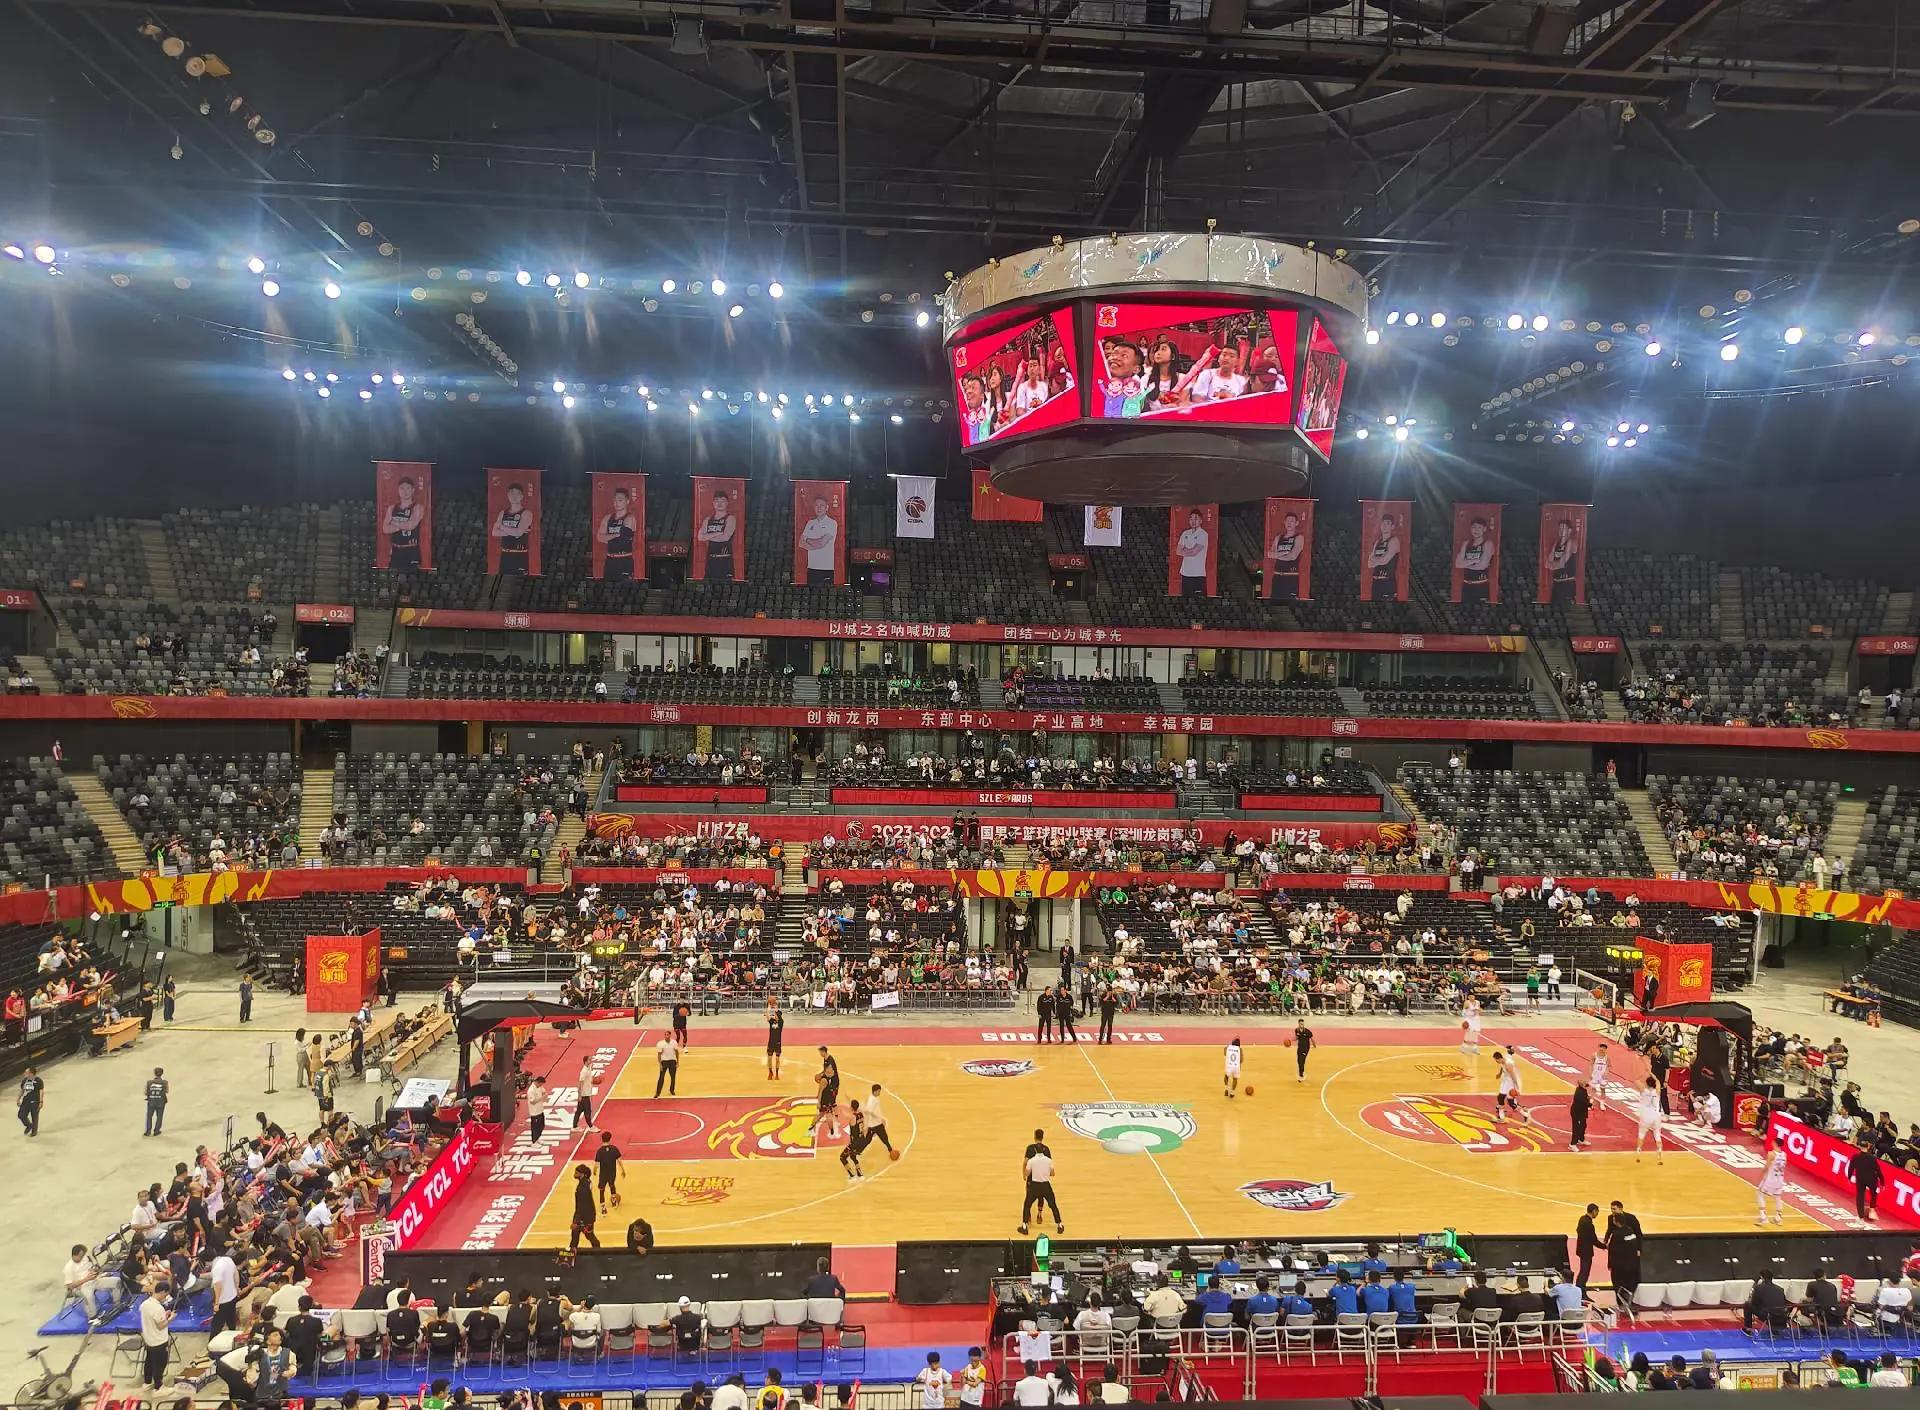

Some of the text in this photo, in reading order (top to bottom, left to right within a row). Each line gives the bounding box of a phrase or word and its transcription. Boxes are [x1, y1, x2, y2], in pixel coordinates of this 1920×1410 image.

[828, 623, 1122, 642] 以城之名呐喊助威 团结一心为城争先
[807, 711, 1213, 731] 创新龙岗 东部中心 产业高地 幸福家园
[1230, 1053, 1237, 1063] 0
[1773, 1123, 1819, 1164] TCL
[423, 1167, 452, 1208] TCL
[394, 1202, 424, 1248] TCL
